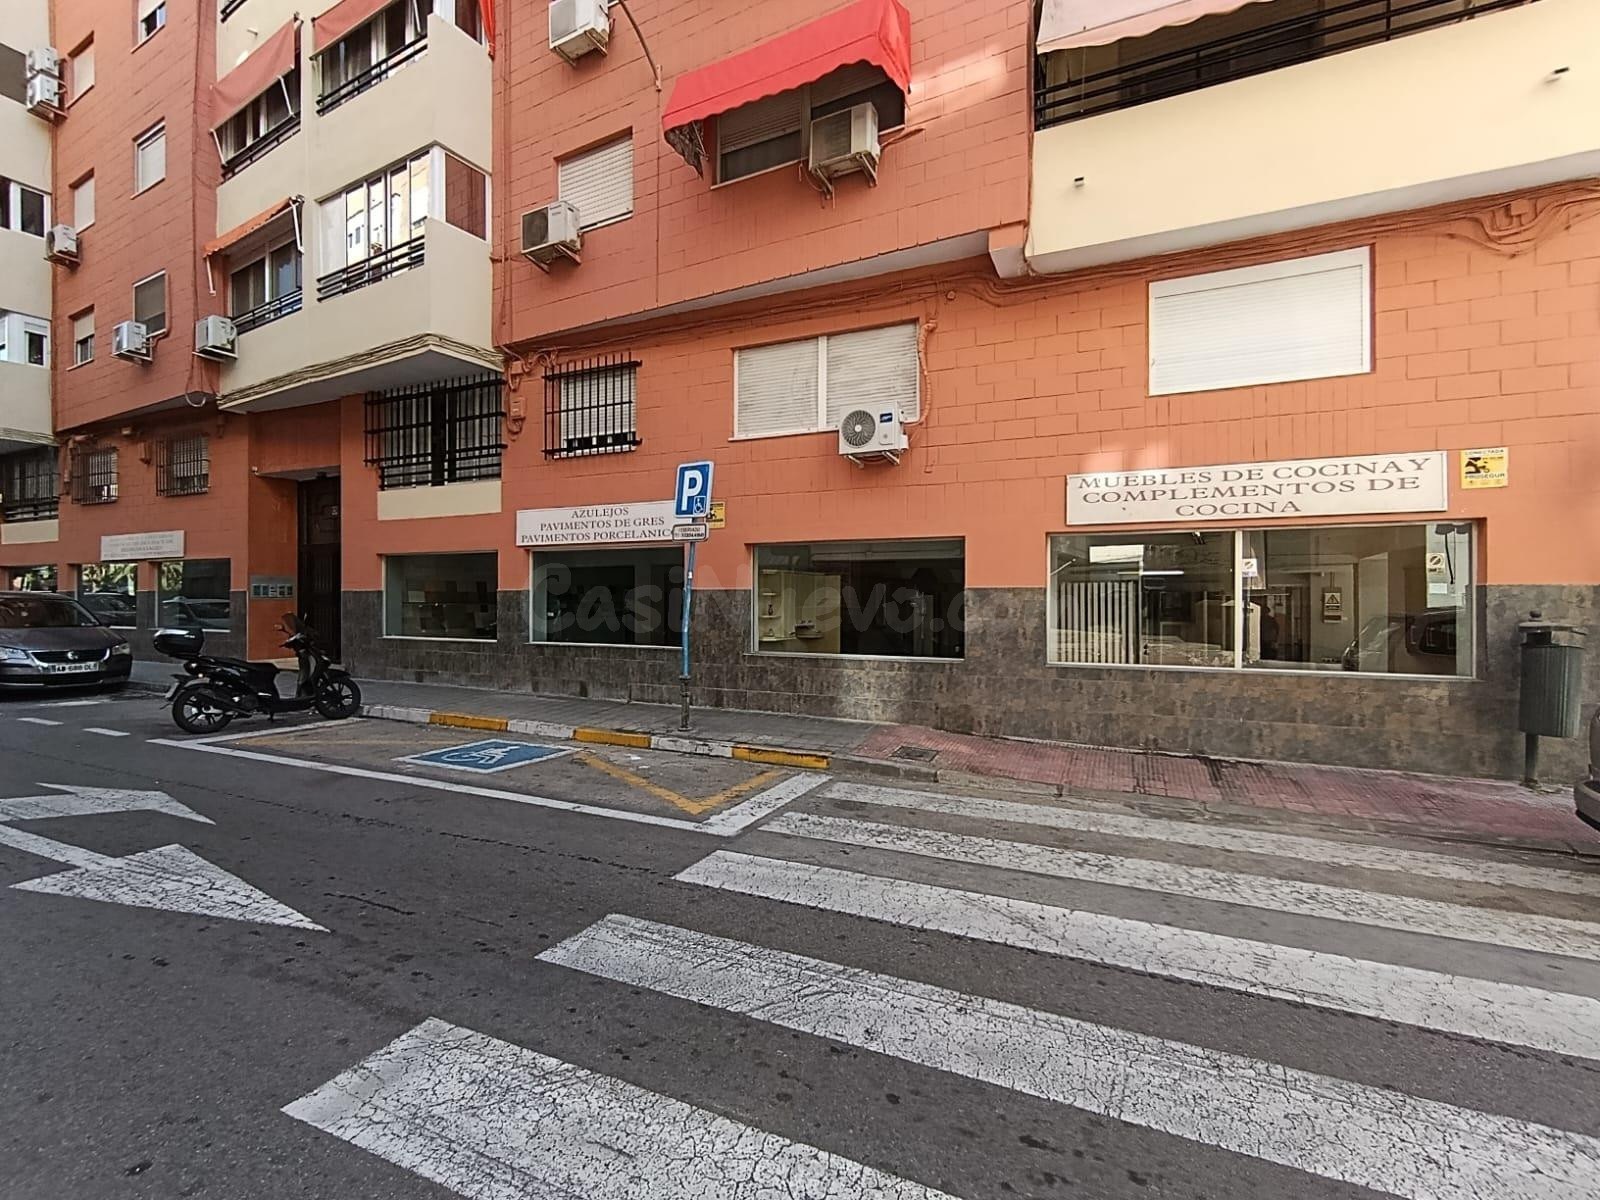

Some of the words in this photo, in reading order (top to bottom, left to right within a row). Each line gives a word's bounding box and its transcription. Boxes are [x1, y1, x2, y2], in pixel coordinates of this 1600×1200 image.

[1078, 472, 1212, 489] MUEBLES
[1222, 468, 1264, 482] DE
[1273, 461, 1403, 479] COCINA
[1408, 457, 1431, 471] Y
[681, 470, 703, 512] P
[1082, 480, 1356, 504] COMPLEMENTOS
[1368, 476, 1420, 491] DE
[571, 507, 629, 519] AZULEJOS
[1175, 501, 1302, 517] COCINA
[540, 519, 612, 532] PAVIMENTOS
[614, 518, 632, 528] DE
[633, 516, 665, 526] GRES
[521, 532, 591, 543] PAVIMENTOS
[593, 528, 673, 541] PORCELANIC
